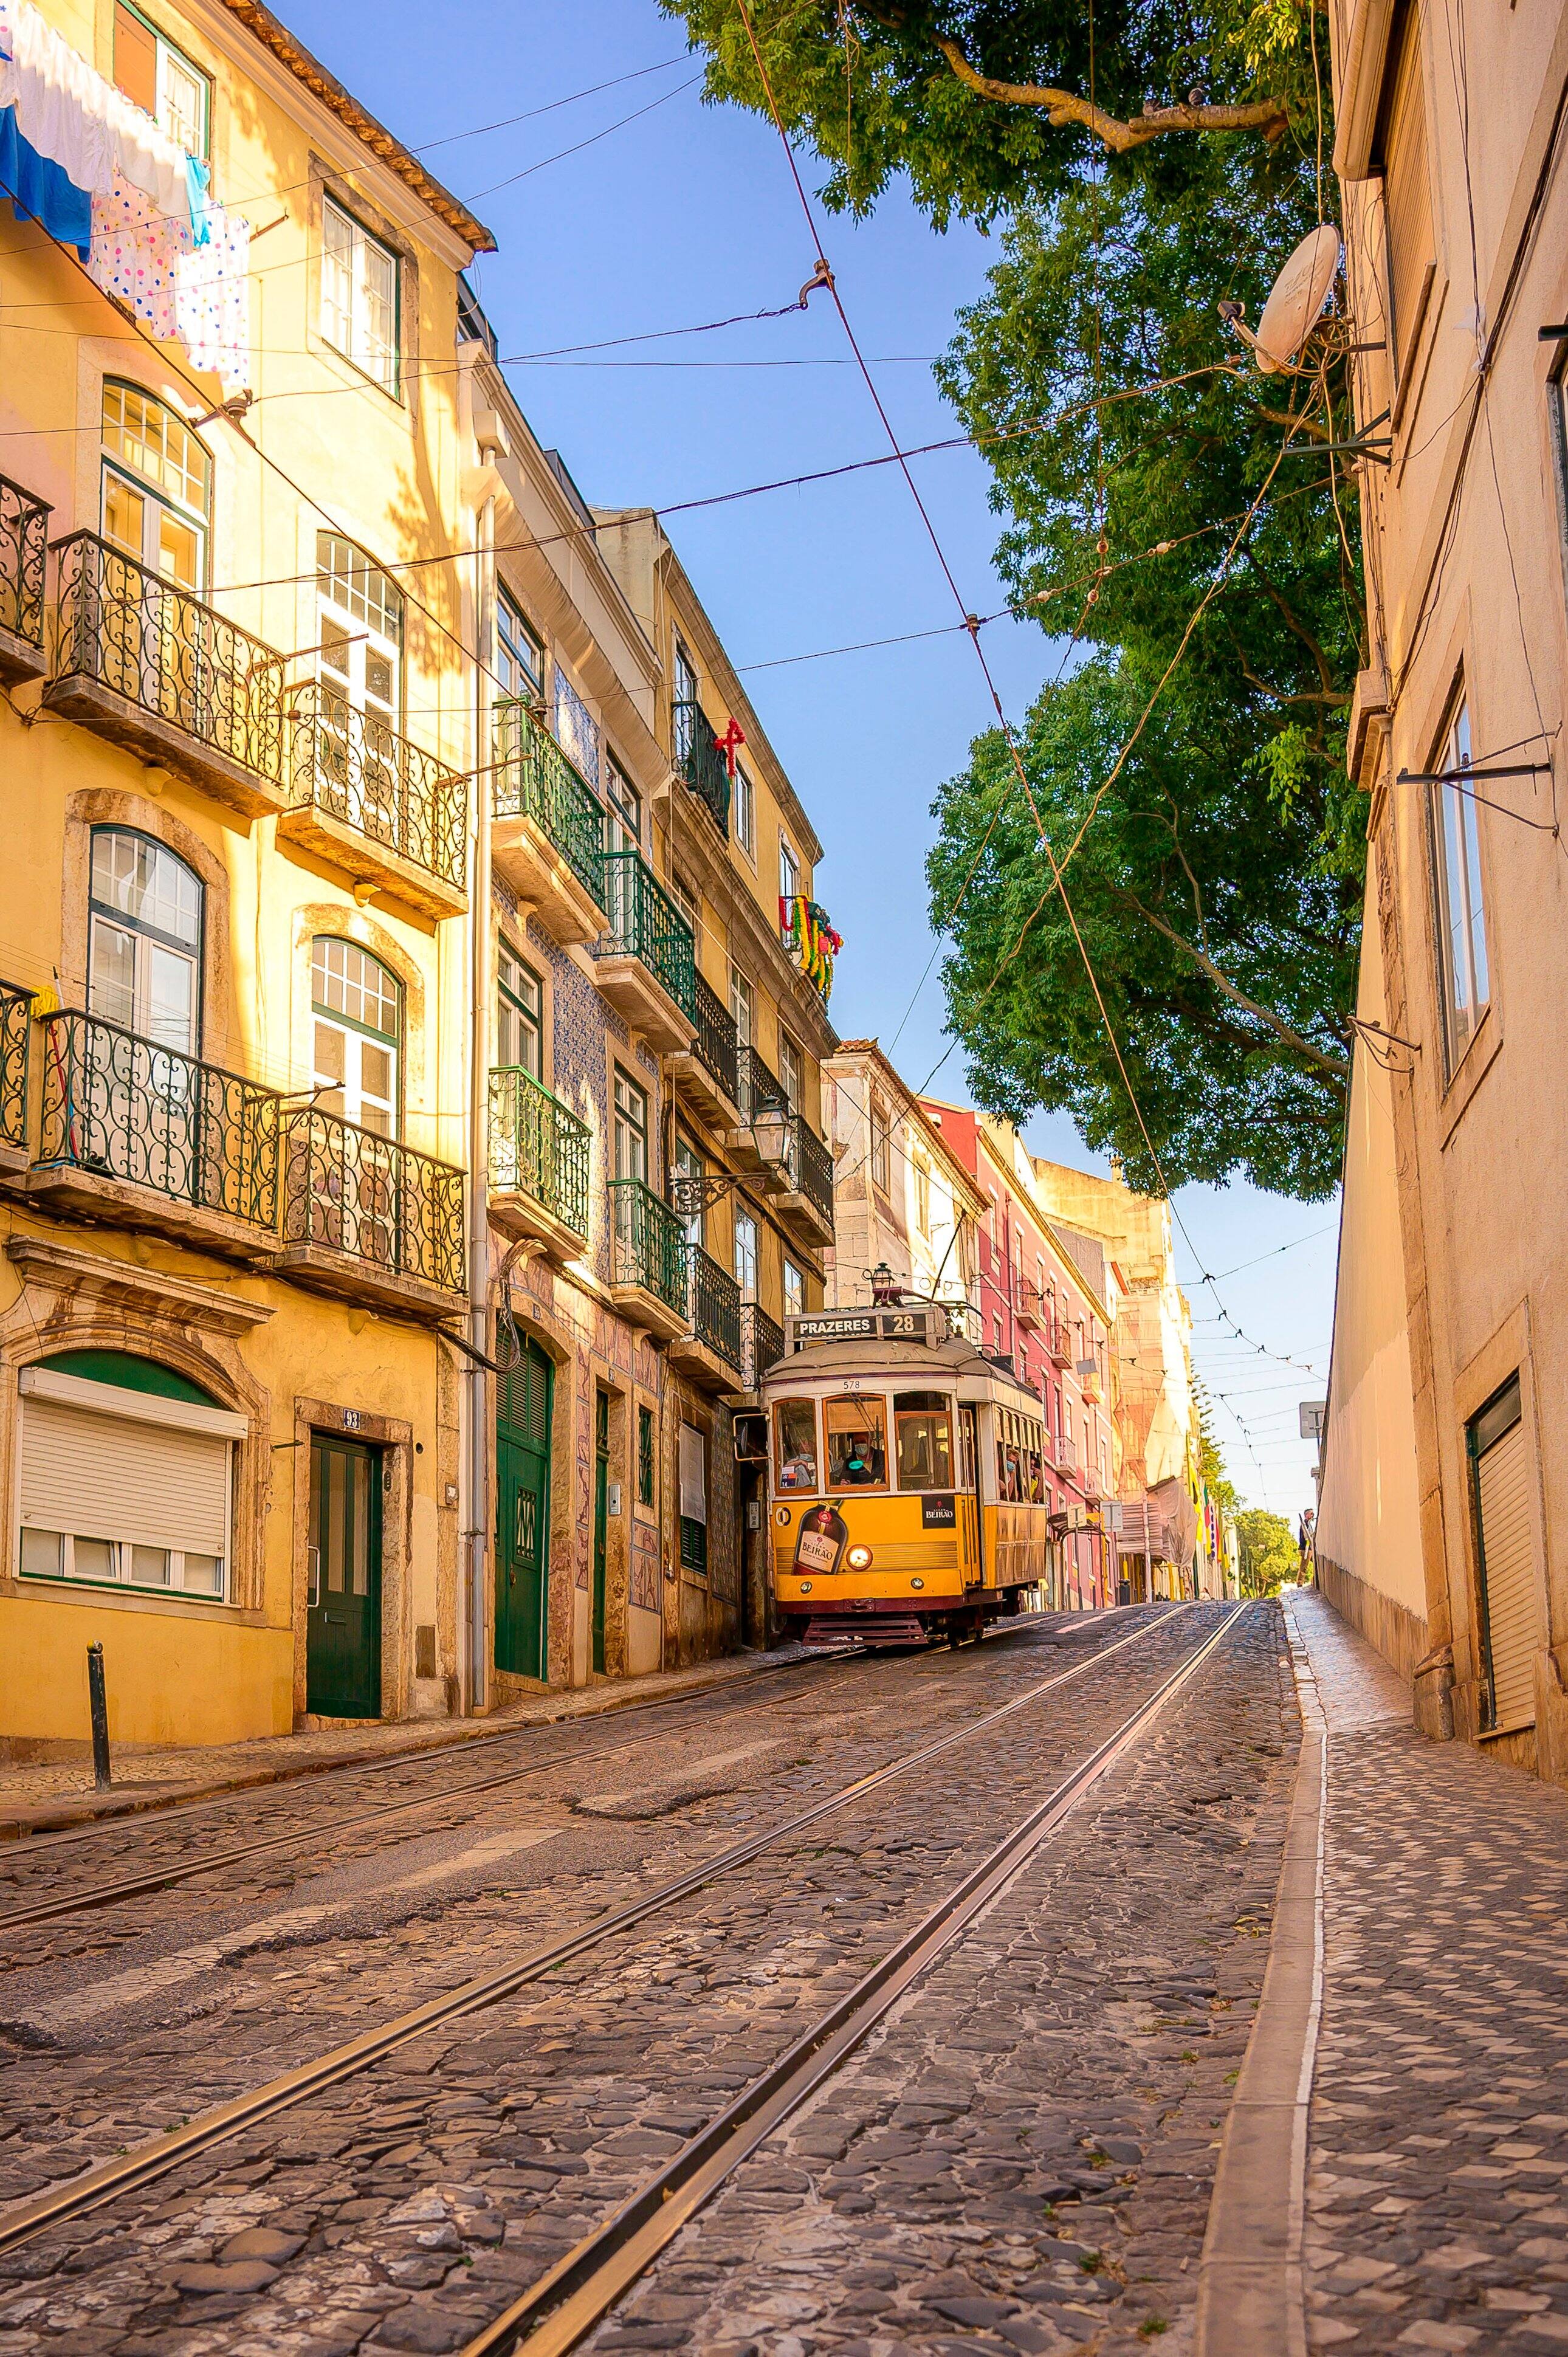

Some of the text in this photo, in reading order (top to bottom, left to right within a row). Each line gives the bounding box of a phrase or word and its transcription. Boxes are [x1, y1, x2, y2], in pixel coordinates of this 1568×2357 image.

[800, 1319, 870, 1334] PRAZERES
[893, 1315, 913, 1332] 28
[843, 1380, 860, 1389] 578
[346, 1411, 357, 1427] 93
[926, 1510, 953, 1519] BEIRÃO
[802, 1542, 833, 1560] BEIRÃO
